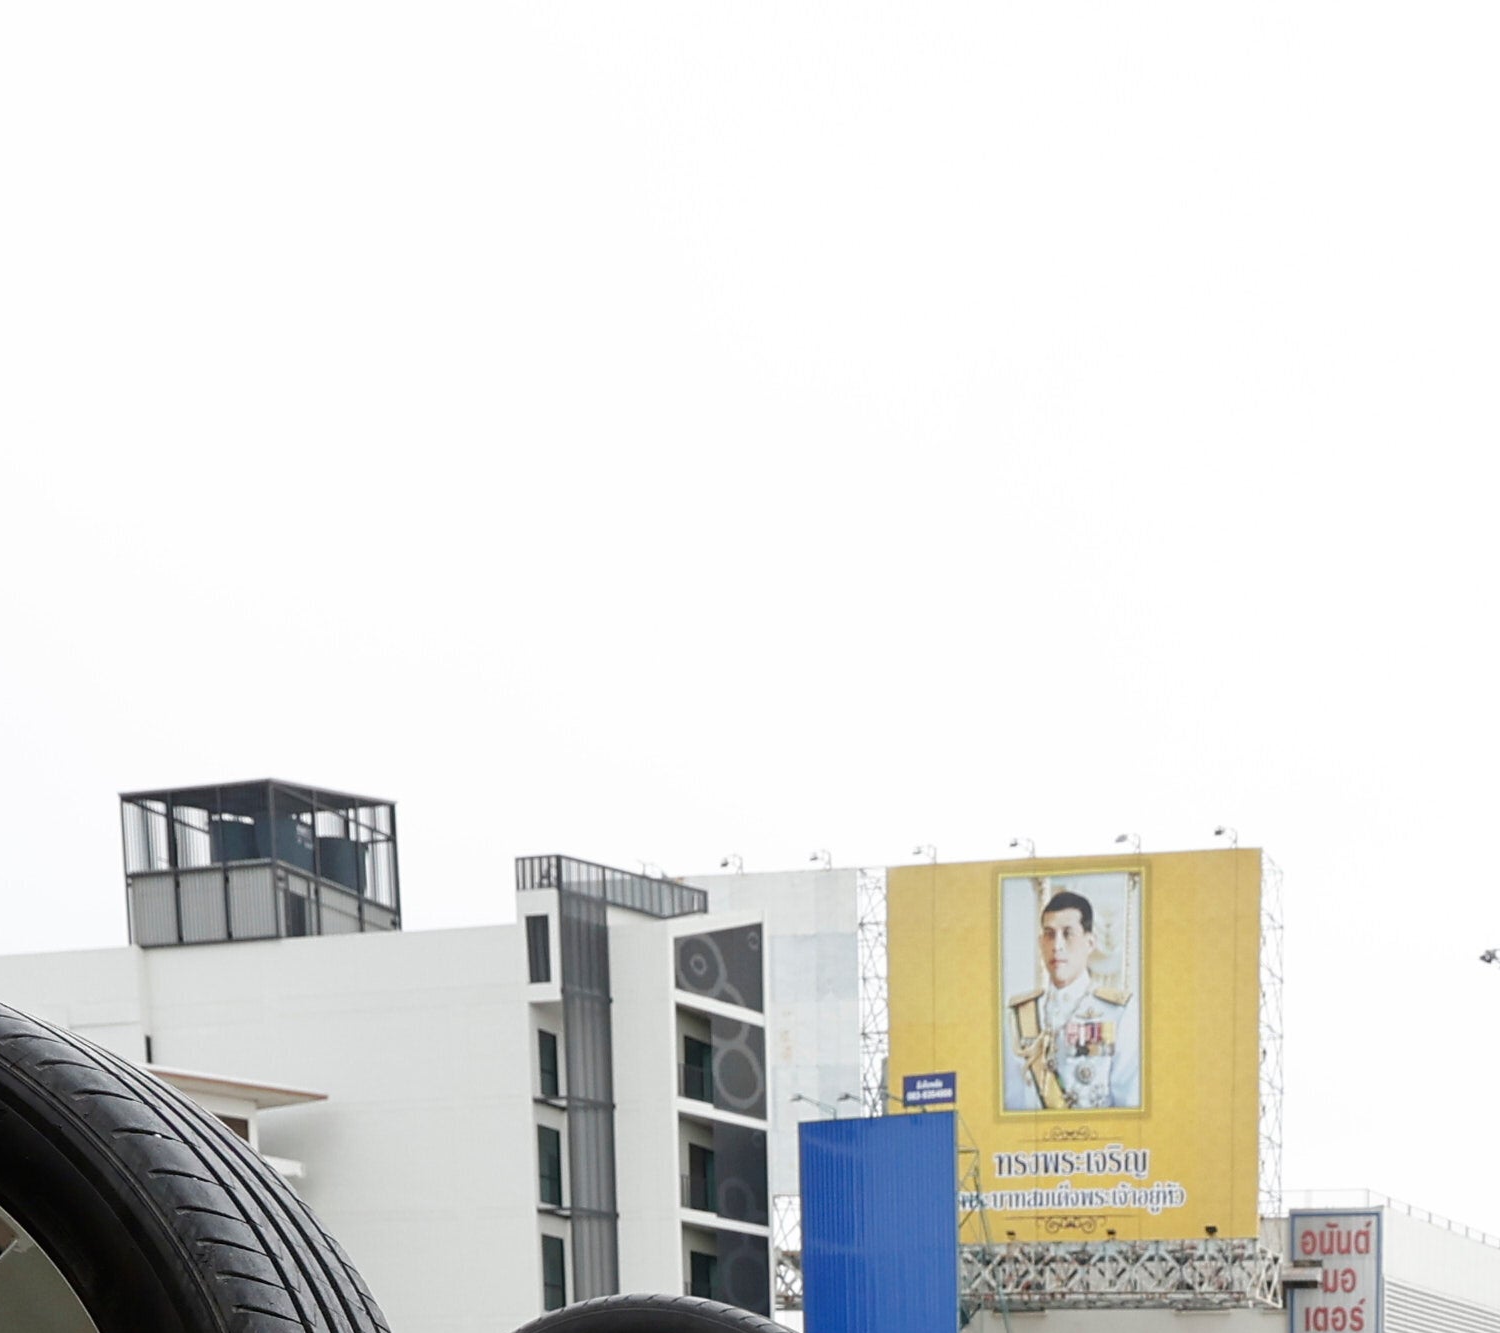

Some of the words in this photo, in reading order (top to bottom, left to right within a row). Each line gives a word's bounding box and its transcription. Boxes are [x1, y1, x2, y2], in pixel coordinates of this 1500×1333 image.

[994, 1144, 1149, 1179] ทรงพระเจริญ
[1301, 1221, 1371, 1255] อนันต์
[1304, 1298, 1366, 1332] เตอร์
